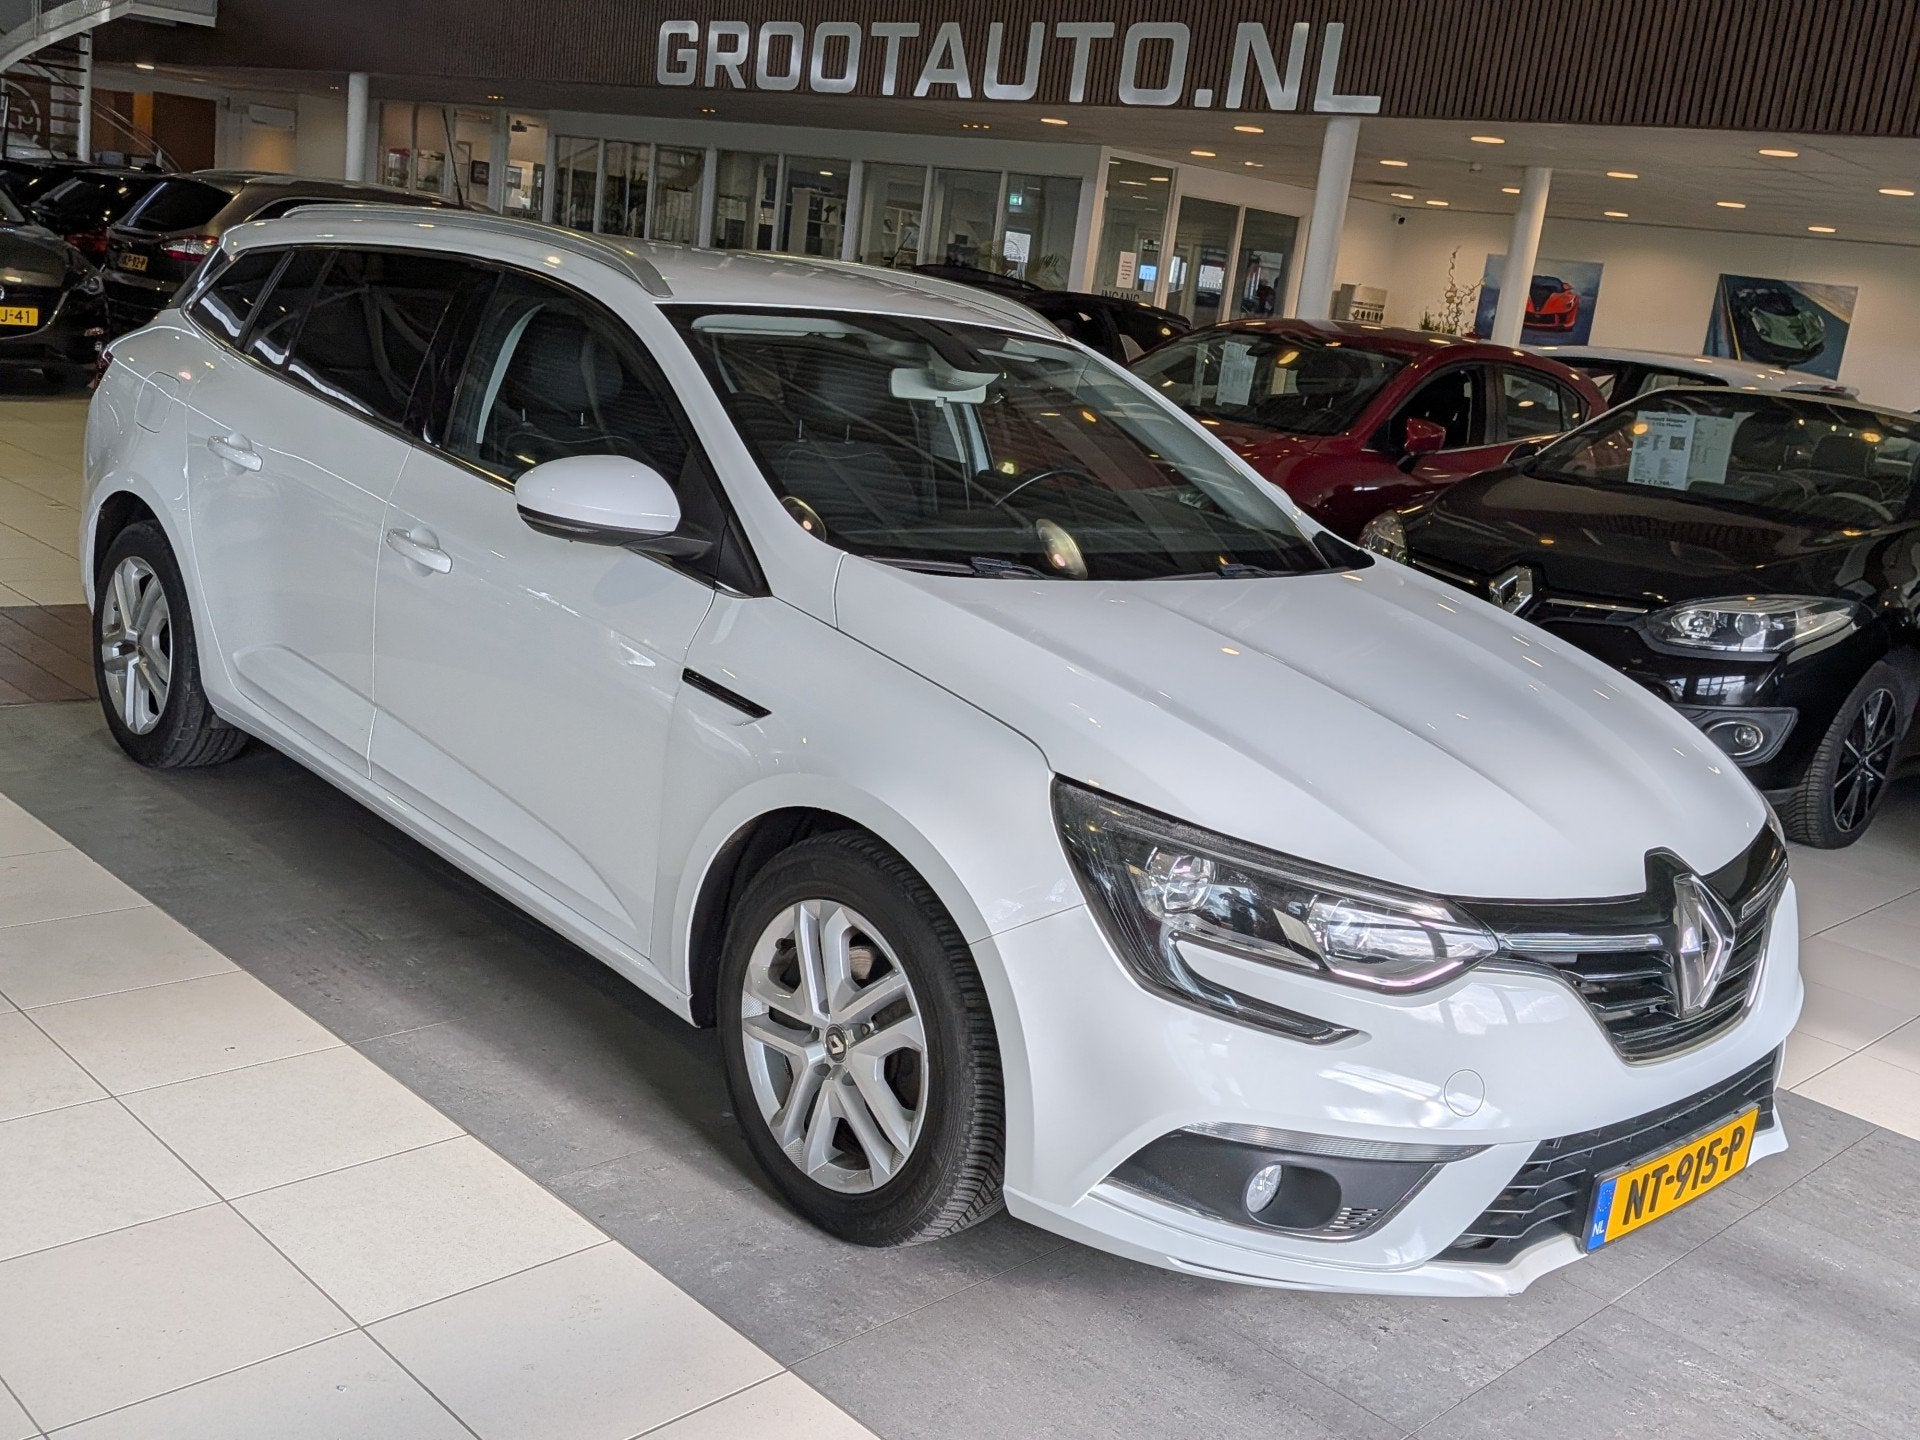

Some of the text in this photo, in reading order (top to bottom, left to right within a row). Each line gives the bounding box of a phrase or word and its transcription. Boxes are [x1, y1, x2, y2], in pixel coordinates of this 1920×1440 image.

[656, 19, 1382, 114] GROOTAUTO.NL
[1622, 1125, 1746, 1226] NT-915-P
[1591, 1221, 1605, 1238] NL
